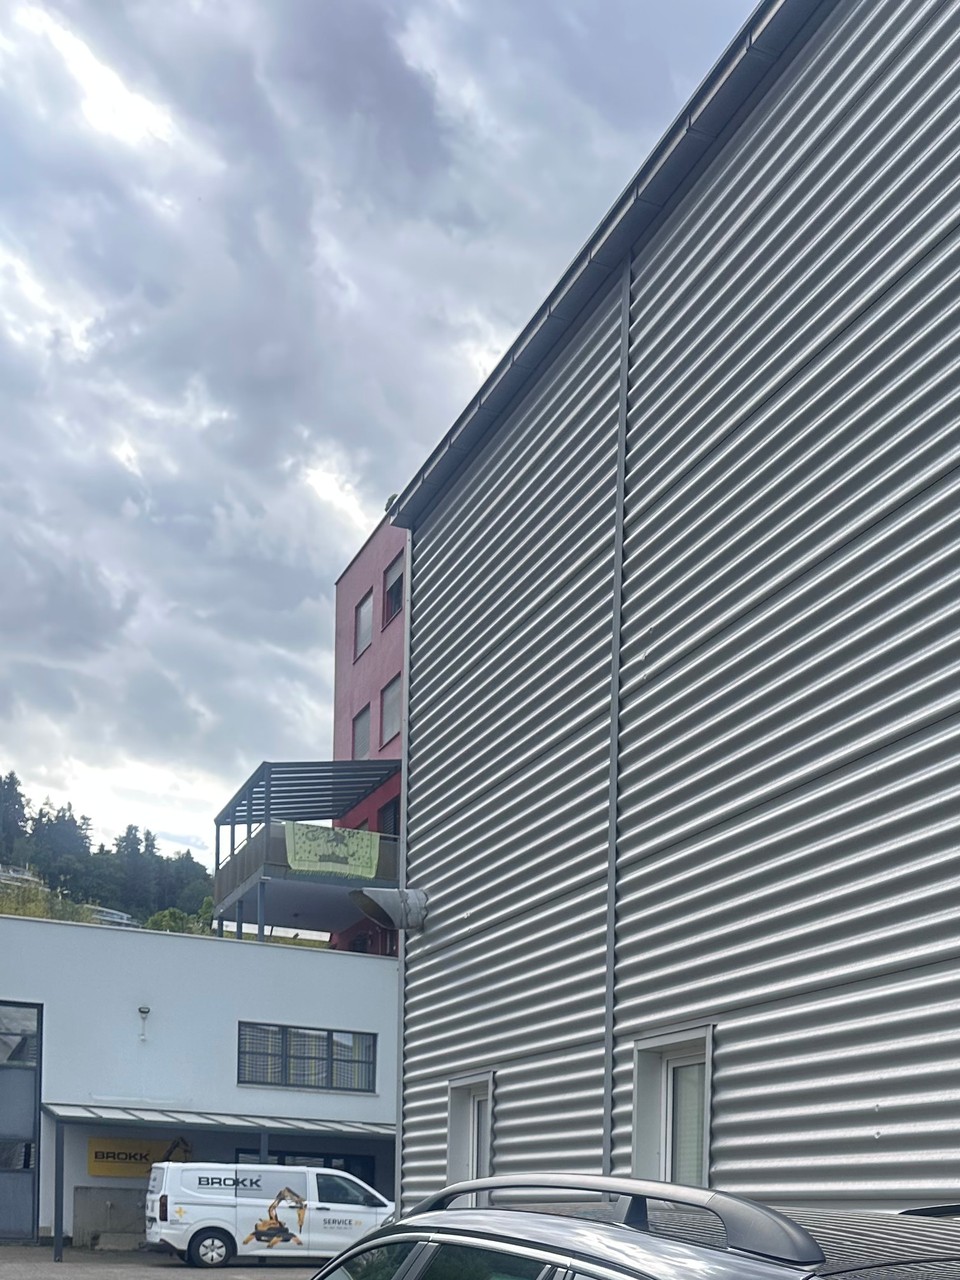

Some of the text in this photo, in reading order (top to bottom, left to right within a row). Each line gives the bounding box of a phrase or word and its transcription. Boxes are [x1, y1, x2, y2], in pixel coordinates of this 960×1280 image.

[94, 1151, 150, 1161] BROKK
[198, 1176, 261, 1188] BROKK
[323, 1218, 353, 1226] SERVICE
